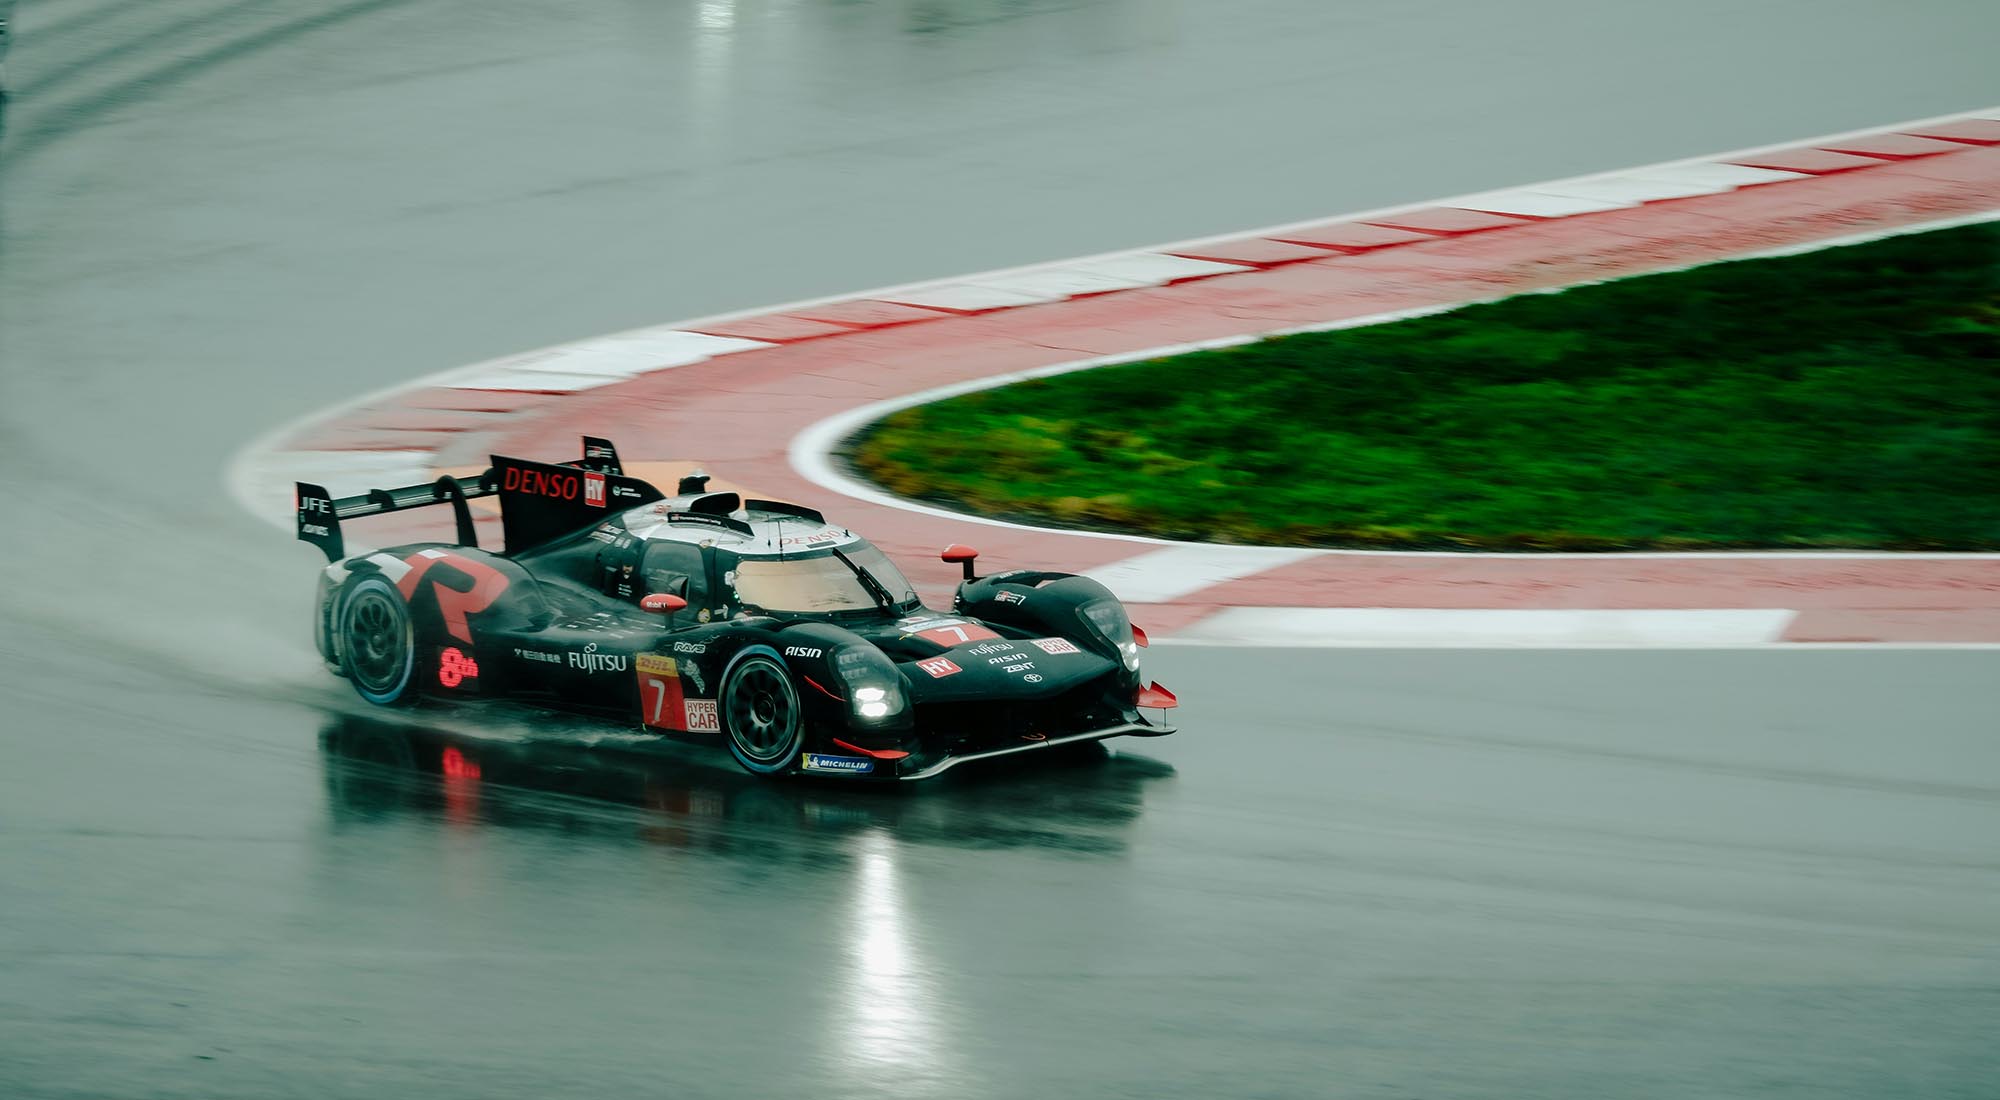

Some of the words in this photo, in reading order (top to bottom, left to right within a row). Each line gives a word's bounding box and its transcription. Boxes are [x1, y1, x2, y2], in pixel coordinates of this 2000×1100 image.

[504, 467, 578, 500] DENSO
[585, 479, 605, 501] HY
[299, 496, 330, 514] JFE
[936, 626, 970, 642] 7
[785, 646, 822, 659] AISIN
[968, 643, 1014, 657] FUJITSU
[1043, 643, 1076, 653] CAR
[568, 651, 627, 675] FUJITSU
[988, 652, 1028, 665] AISIN
[922, 660, 955, 675] HY
[1002, 661, 1035, 673] ZENT
[648, 679, 665, 724] 7
[687, 702, 716, 713] HYPER
[689, 712, 719, 730] CAR
[820, 759, 868, 769] MICHELIN
